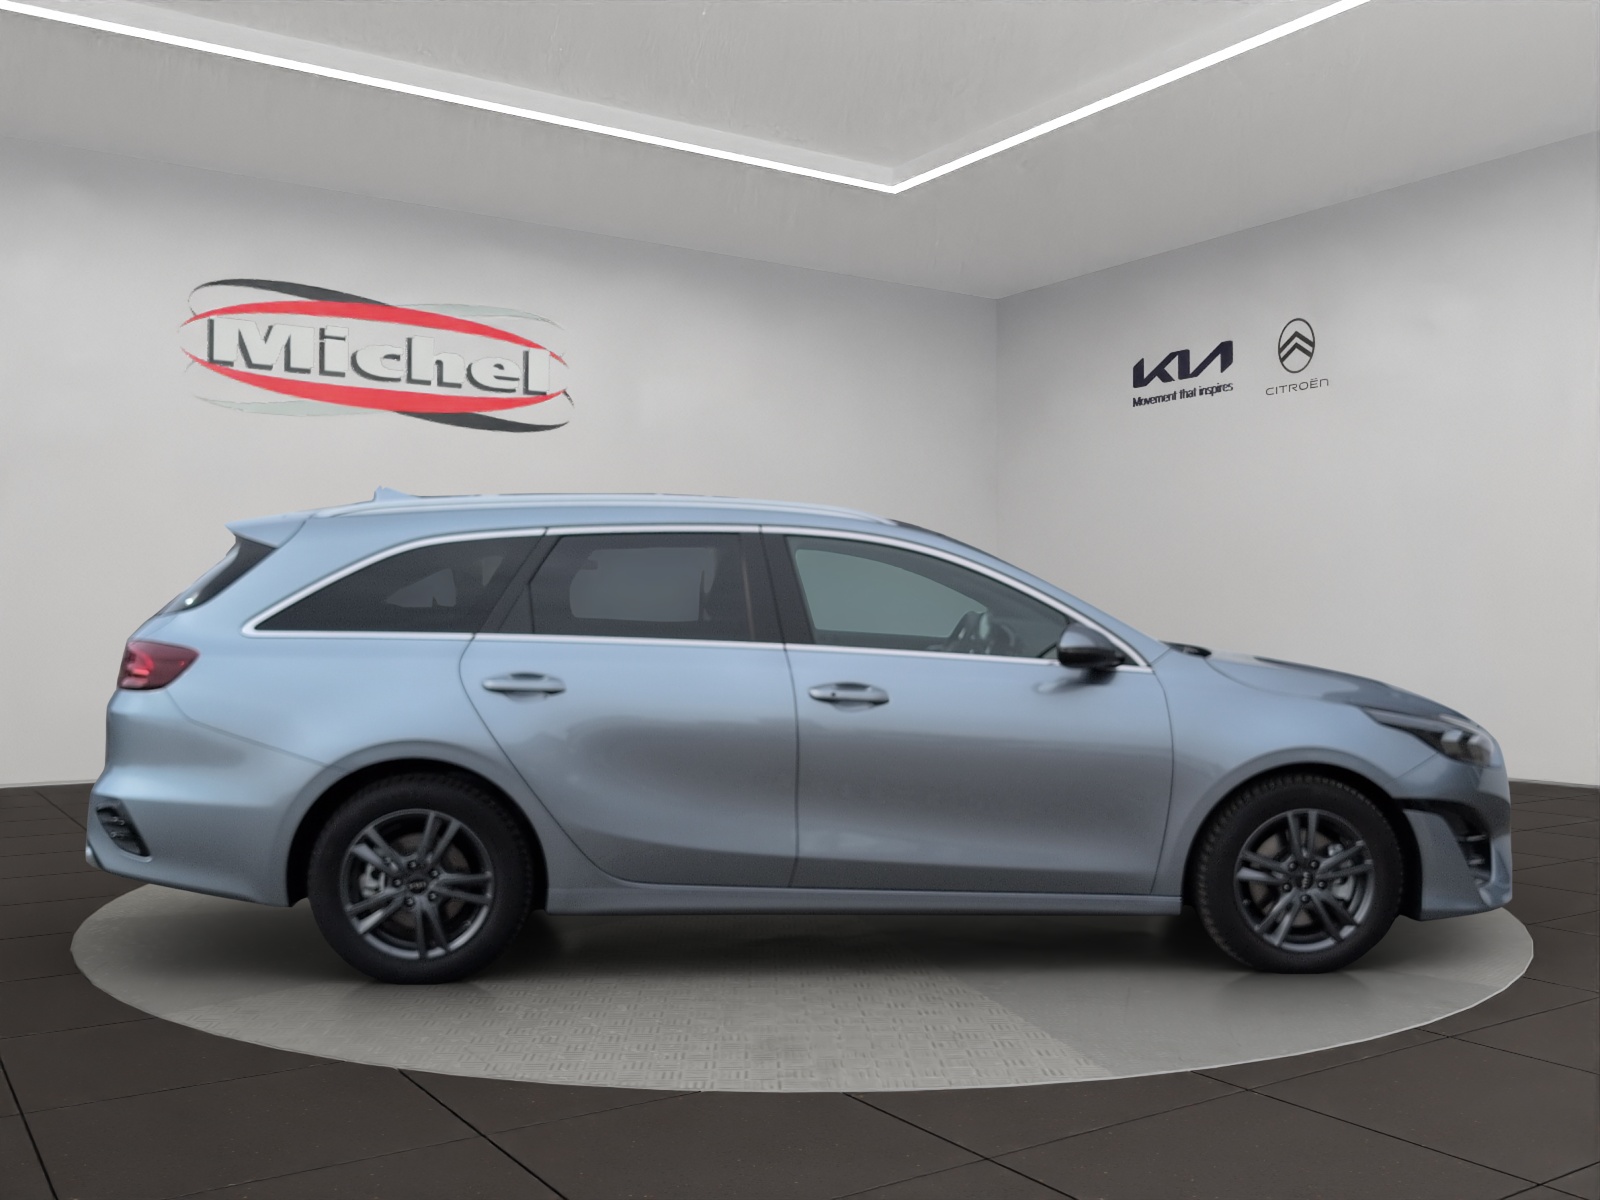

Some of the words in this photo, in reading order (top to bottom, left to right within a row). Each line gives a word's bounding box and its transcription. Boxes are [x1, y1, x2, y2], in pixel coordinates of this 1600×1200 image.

[207, 317, 550, 396] Michel
[1133, 340, 1233, 388] KIA
[1132, 390, 1177, 407] Movement
[1179, 386, 1197, 400] that
[1198, 382, 1233, 397] inspires
